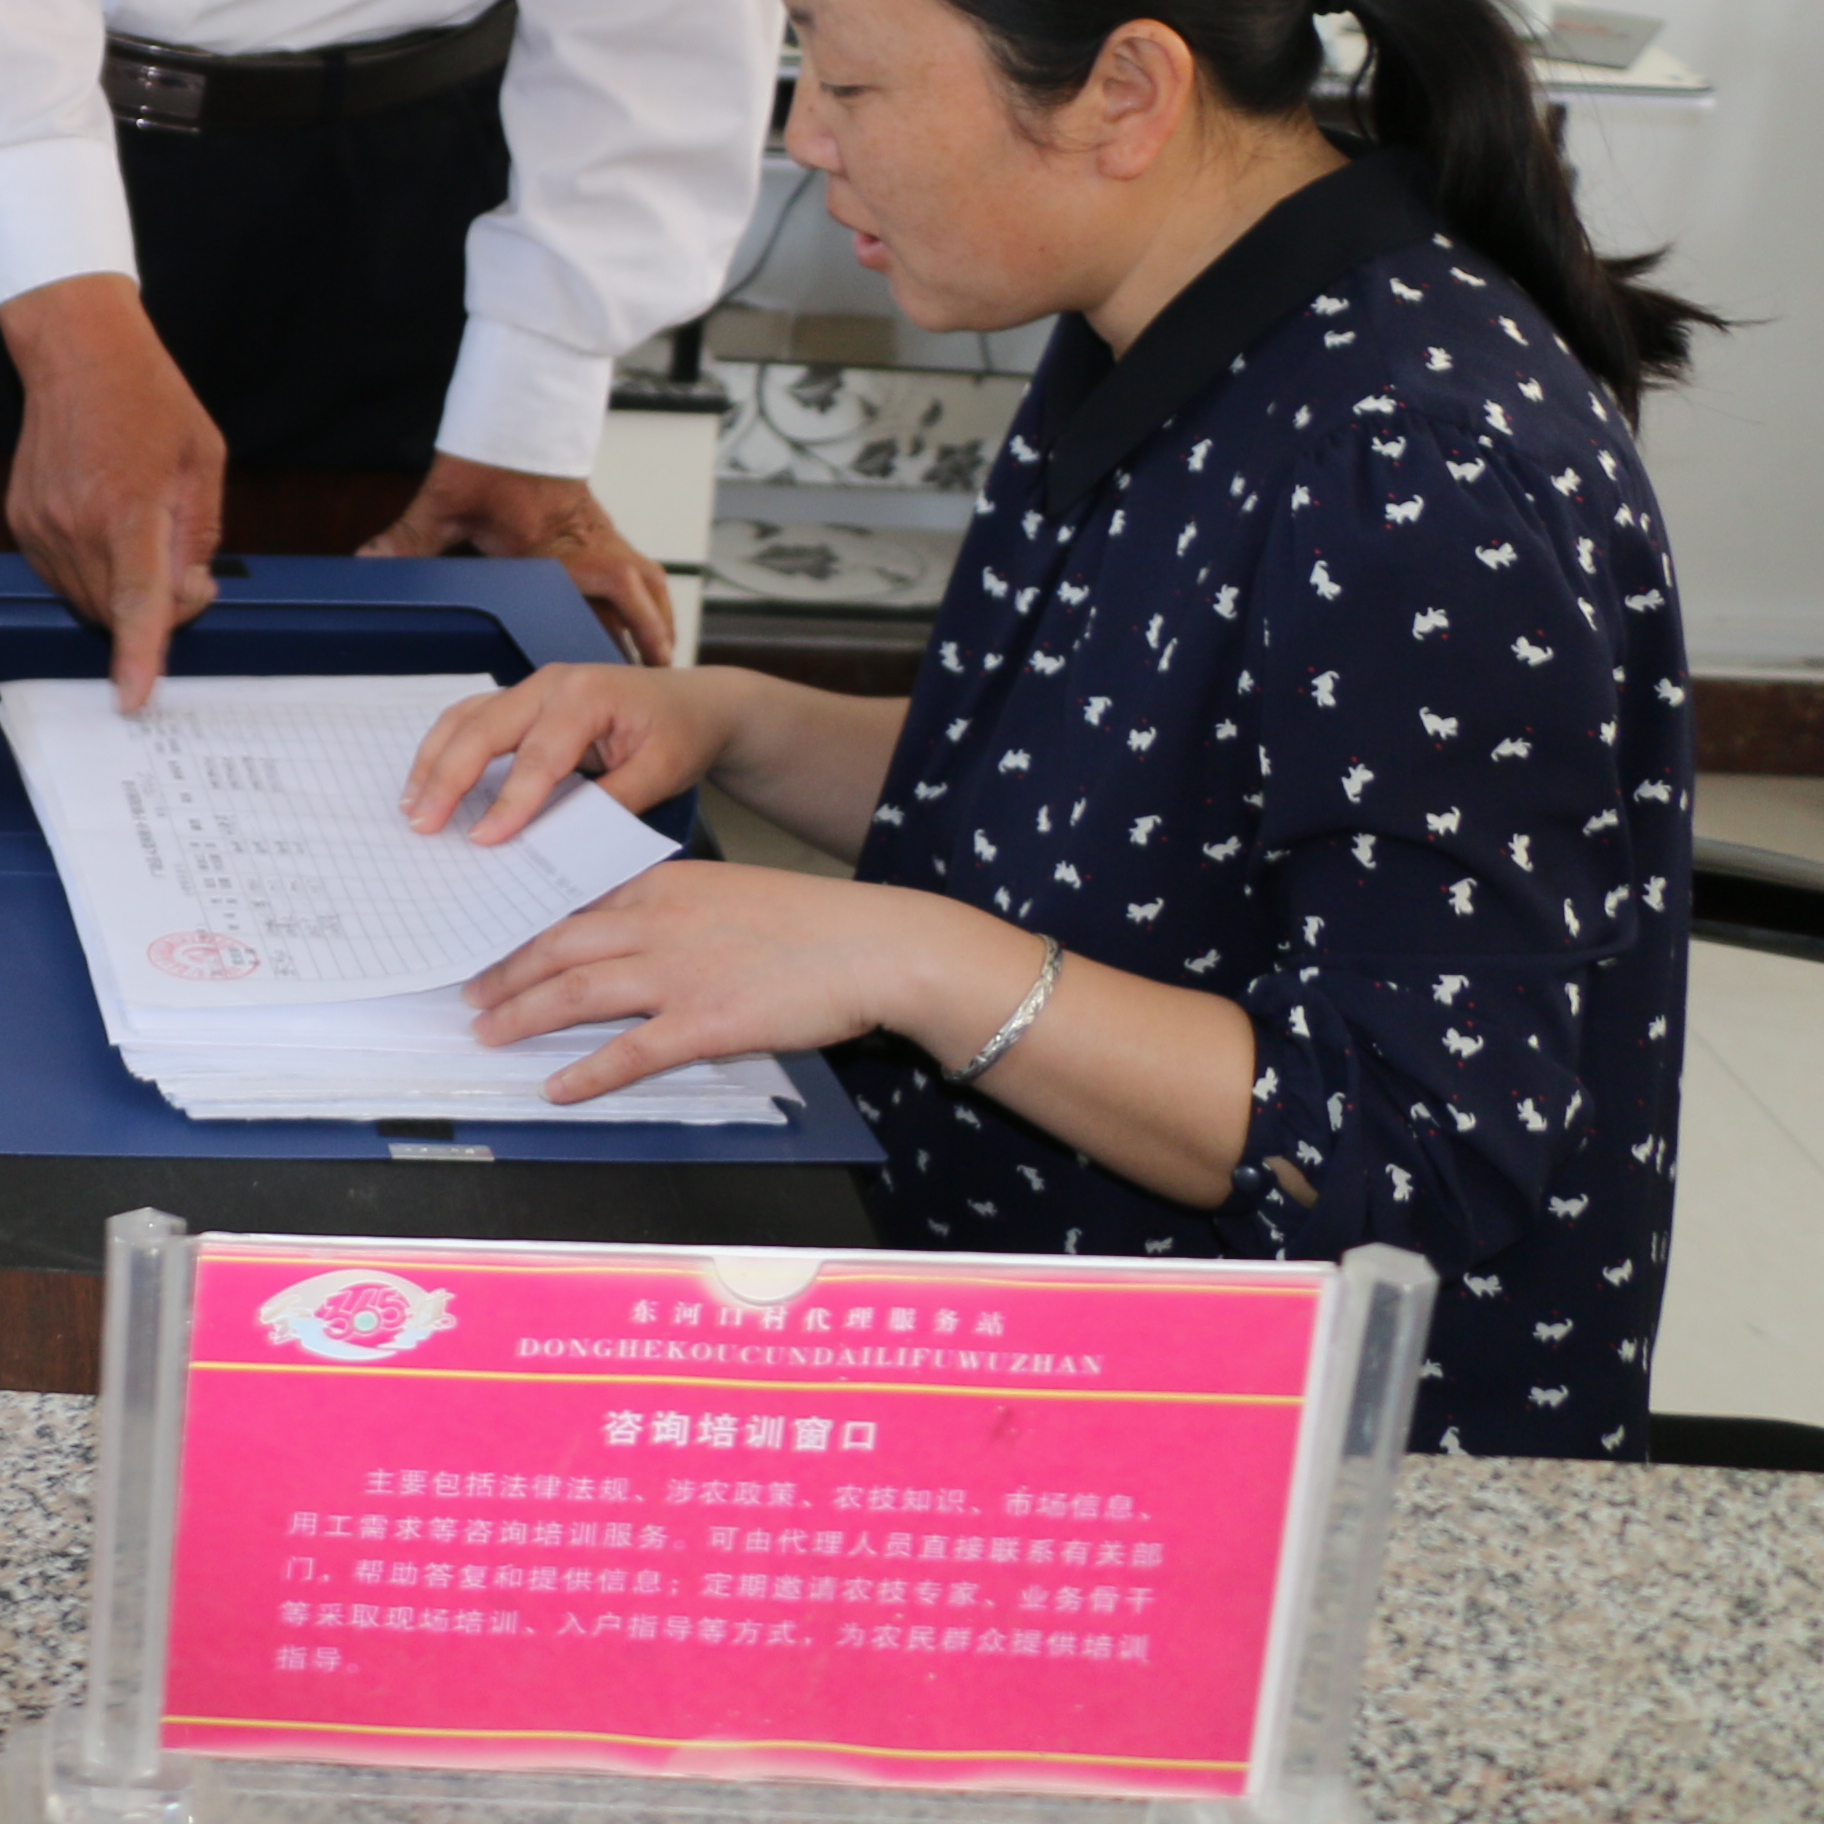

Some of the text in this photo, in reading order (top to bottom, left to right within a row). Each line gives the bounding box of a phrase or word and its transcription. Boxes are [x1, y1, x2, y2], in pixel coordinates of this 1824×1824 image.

[629, 1298, 1007, 1337] 东河口村代理服务站
[516, 1336, 1104, 1375] DONGHEKOUCUNDAILIFUWUZHAN
[604, 1409, 877, 1451] 咨询培训窗口
[275, 1645, 359, 1674] 指导。
